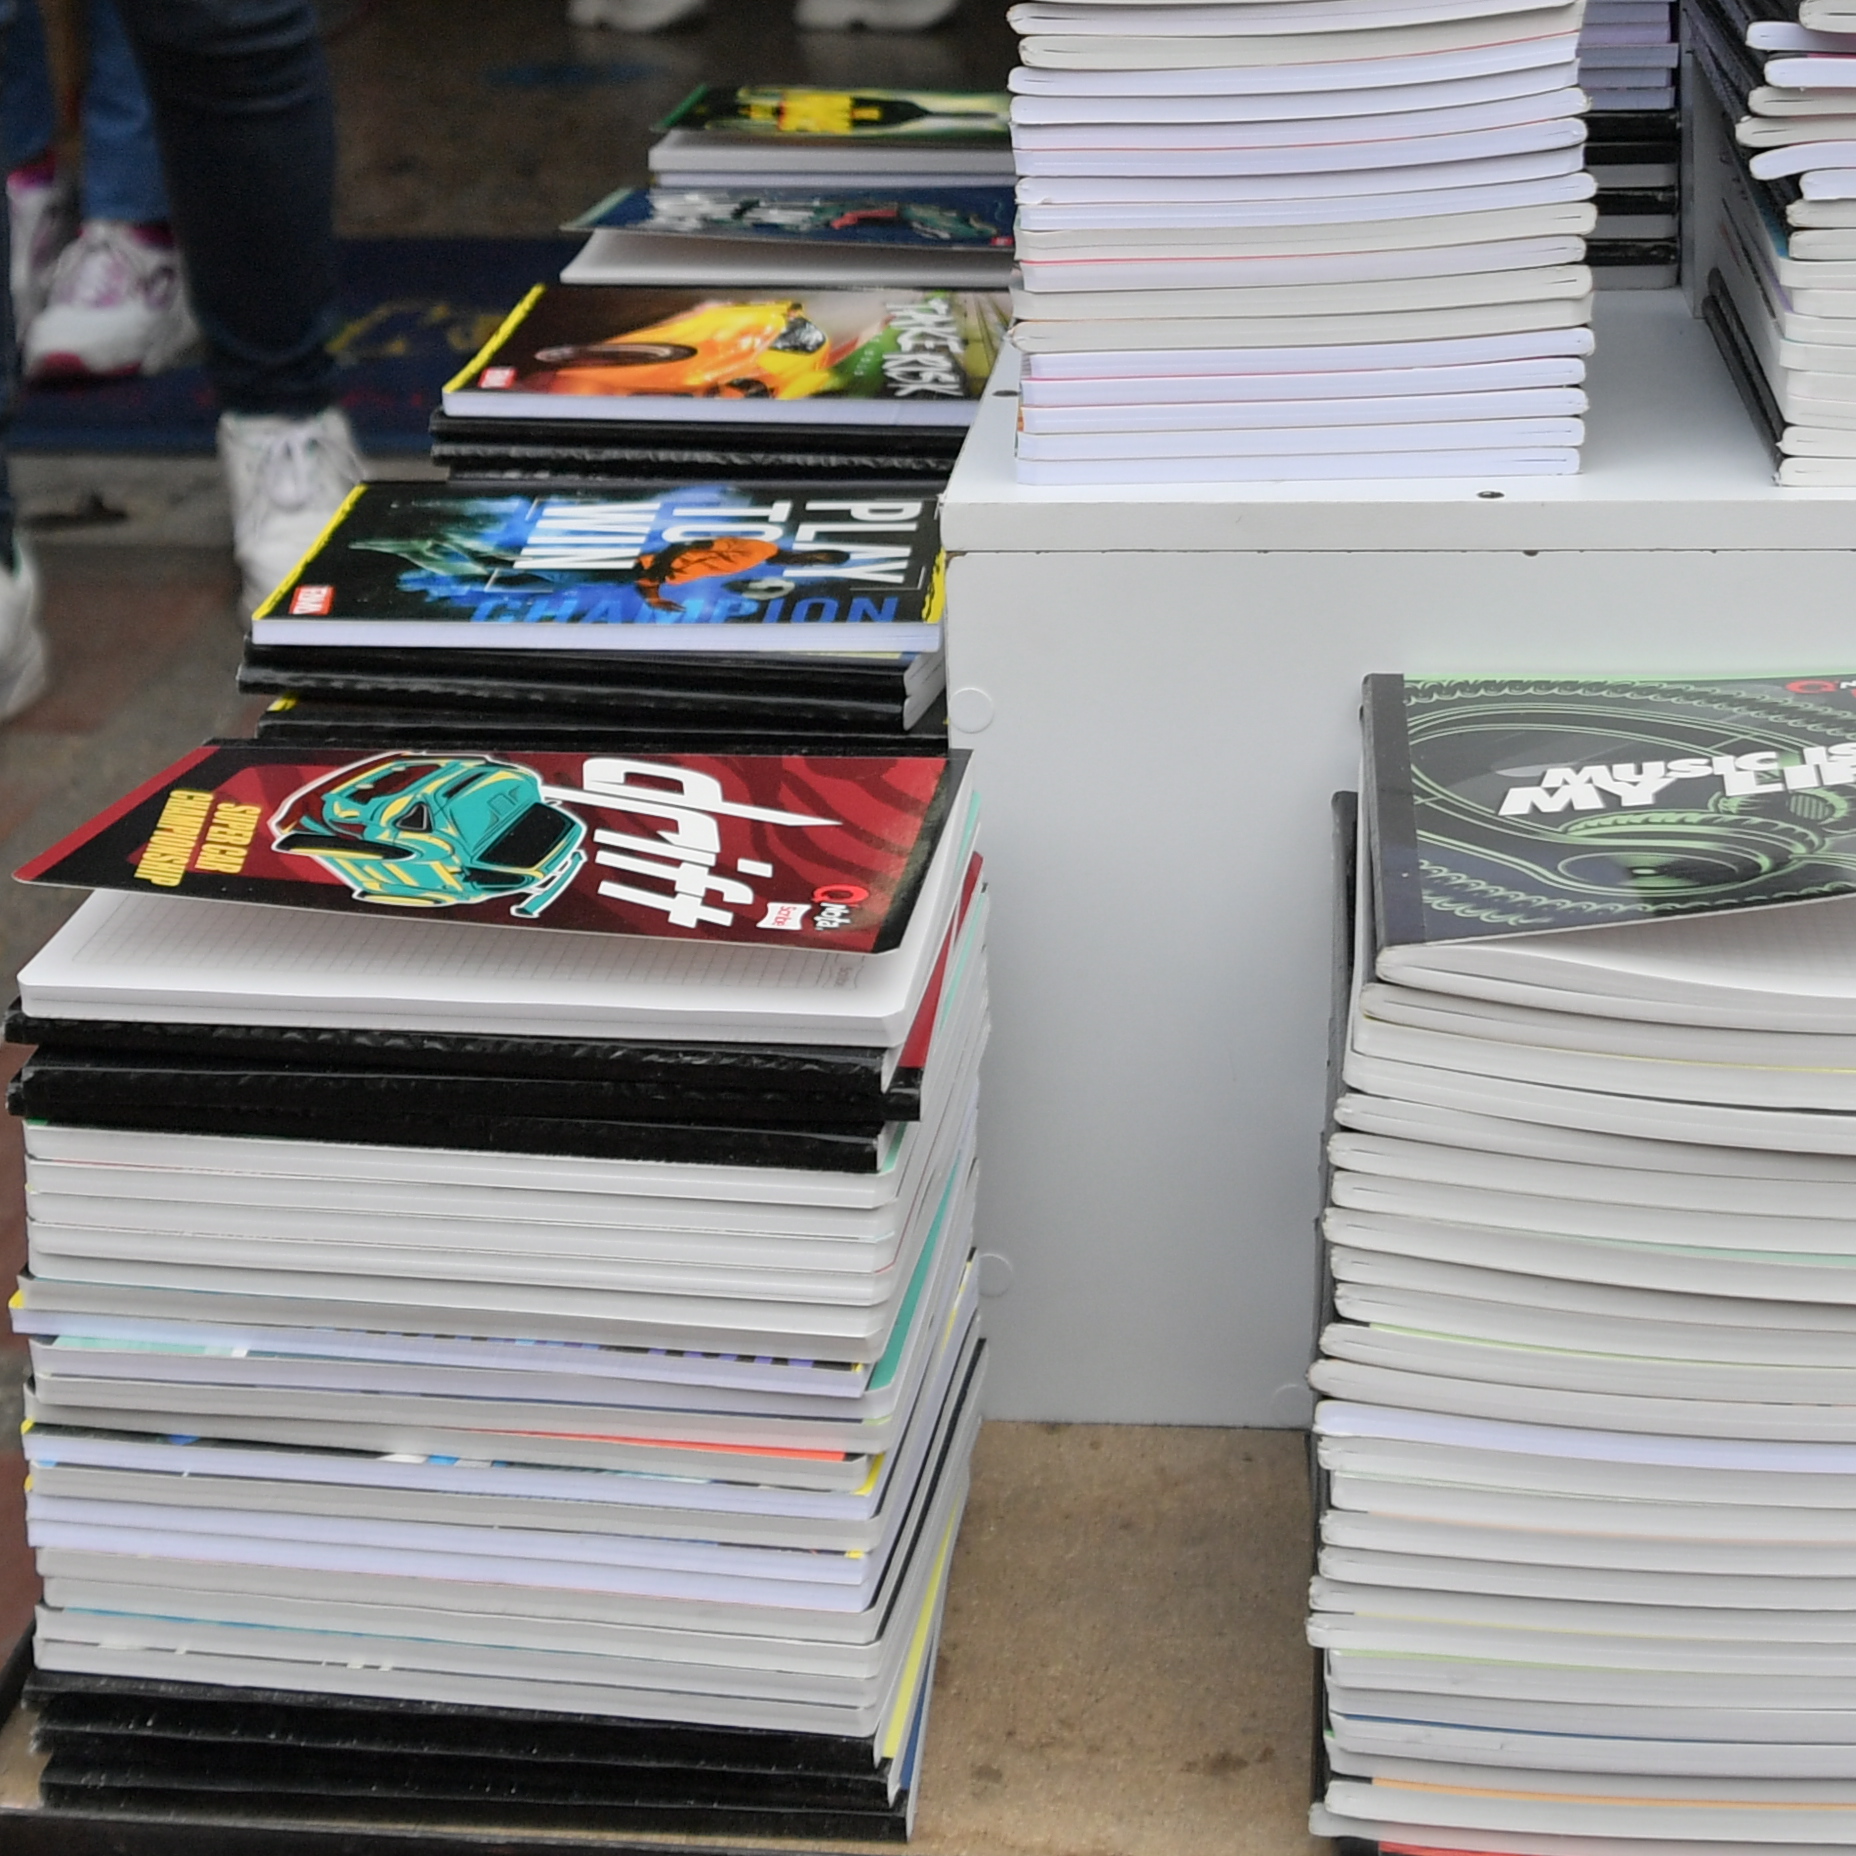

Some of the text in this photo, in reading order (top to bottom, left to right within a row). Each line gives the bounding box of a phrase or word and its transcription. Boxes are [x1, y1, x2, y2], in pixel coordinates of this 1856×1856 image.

[886, 297, 965, 353] TAKE
[881, 352, 964, 396] RISK
[511, 502, 662, 570] WIN
[660, 501, 792, 545] TO
[782, 501, 924, 583] PLAY
[469, 595, 901, 624] CHAMPION
[1541, 750, 1781, 790] MUSIC
[1497, 779, 1677, 817] MY
[133, 790, 215, 887] CHAMPIONSHIP
[204, 801, 262, 846] SUPER
[541, 757, 844, 929] drift
[193, 843, 249, 874] CAR
